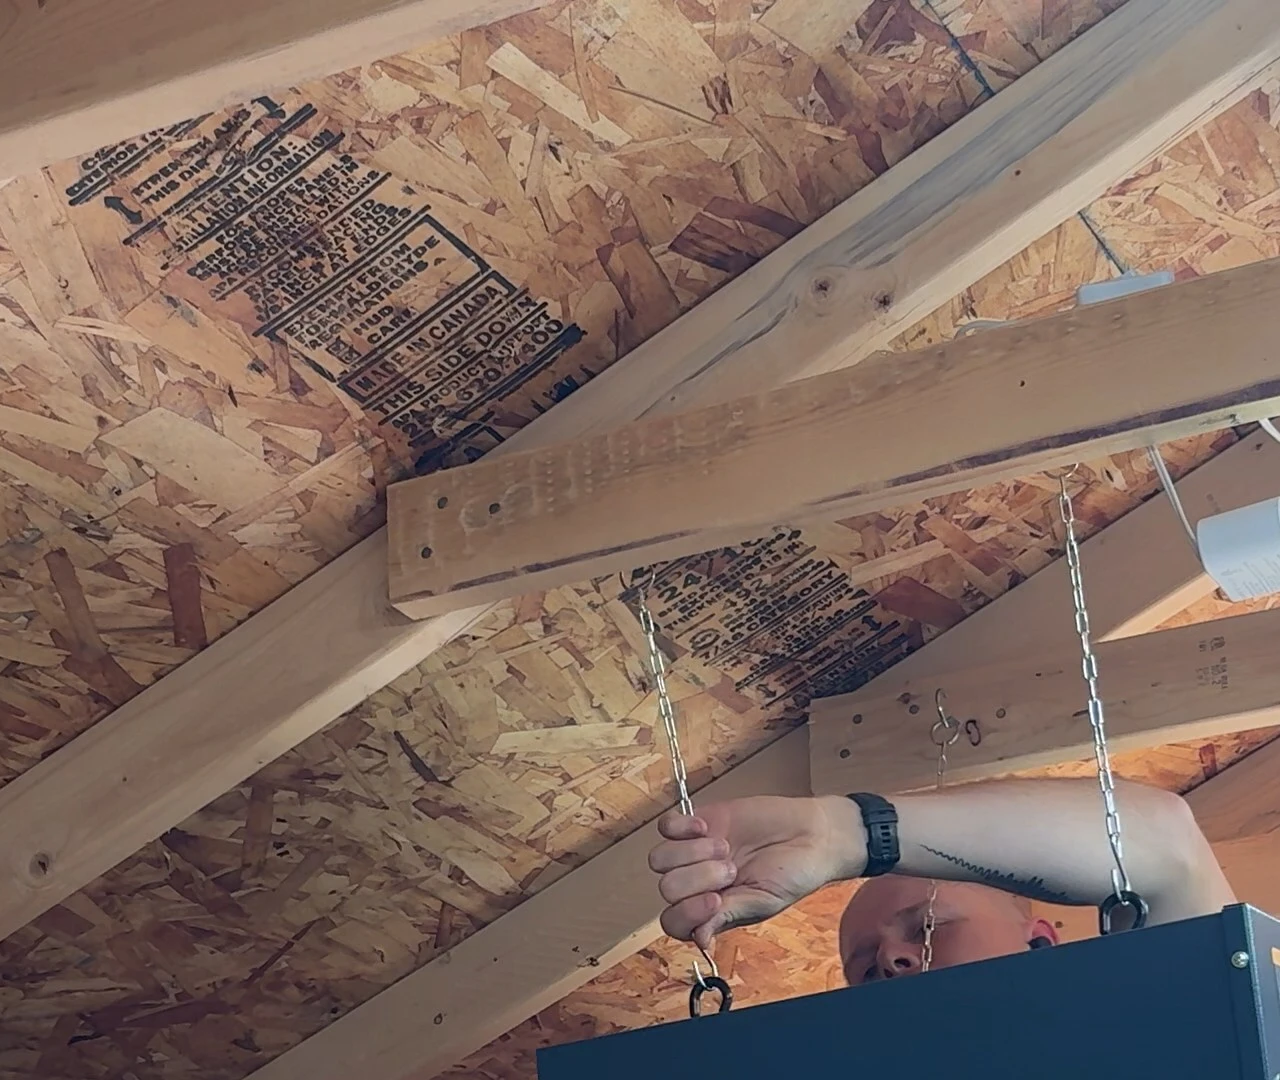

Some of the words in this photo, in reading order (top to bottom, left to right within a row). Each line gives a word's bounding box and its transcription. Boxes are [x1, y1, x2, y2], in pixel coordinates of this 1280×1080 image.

[139, 178, 181, 209] THIS
[215, 220, 248, 244] FOR
[246, 175, 309, 221] PROPER
[241, 129, 337, 199] INFORMATION
[185, 196, 297, 278] PERFORMANCE
[294, 153, 355, 198] PANELS
[197, 253, 236, 282] MUST
[240, 233, 263, 251] BE
[260, 176, 341, 235] INSTALLED
[340, 161, 360, 177] IN
[207, 274, 239, 298] APA
[235, 169, 382, 276] RECOMMENDATIONS
[217, 208, 315, 280] ACCORDANCE
[314, 177, 356, 208] WITH
[242, 197, 378, 296] RECOMMENDED
[250, 262, 307, 304] PANEL
[308, 202, 389, 261] SPACING
[280, 260, 325, 293] INCH
[324, 242, 350, 261] AT
[348, 203, 401, 243] ENDS
[283, 269, 329, 303] INCH
[327, 253, 351, 271] AT
[350, 206, 414, 253] EDGES
[282, 281, 358, 337] EXEMPT
[354, 242, 412, 285] FROM
[293, 234, 443, 344] FORMALDEHYDE
[303, 258, 431, 352] REGULATIONS
[351, 303, 396, 336] HUD
[353, 349, 413, 393] MADE
[405, 335, 432, 356] IN
[425, 282, 503, 340] CANADA
[371, 377, 427, 419] THIS
[423, 342, 477, 382] SIDE
[471, 295, 540, 346] DOWN
[390, 405, 423, 429] APA
[418, 358, 488, 410] PRODUCT
[677, 556, 763, 613] EXPOSURE
[717, 576, 770, 612] 492
[744, 570, 837, 632] CATEGORY
